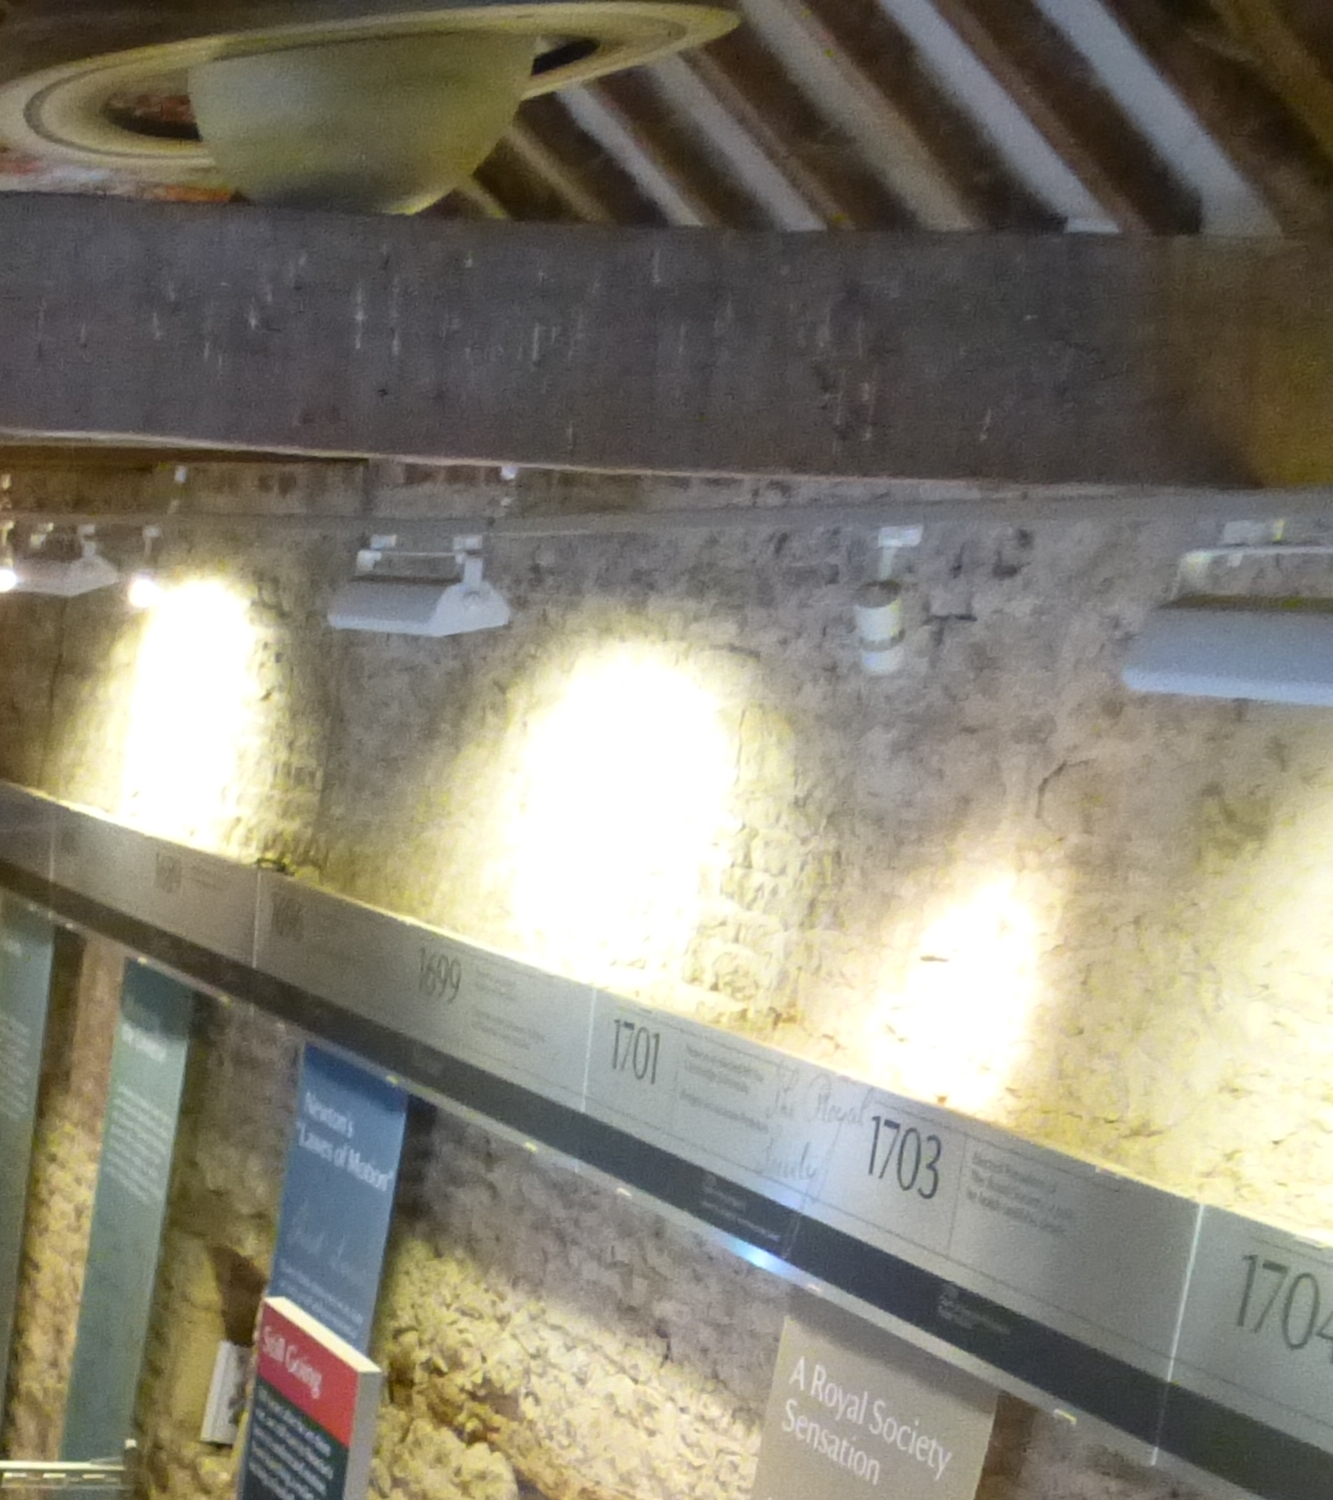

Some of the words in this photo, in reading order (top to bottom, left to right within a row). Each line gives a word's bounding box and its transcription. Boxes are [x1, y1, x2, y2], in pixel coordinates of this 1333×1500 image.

[418, 946, 464, 1005] 1699
[611, 1018, 661, 1085] 1701
[867, 1115, 943, 1200] 1703
[782, 1398, 882, 1486] Sensation
[789, 1355, 807, 1392] A
[811, 1364, 869, 1426] Royal
[868, 1400, 953, 1481] Society
